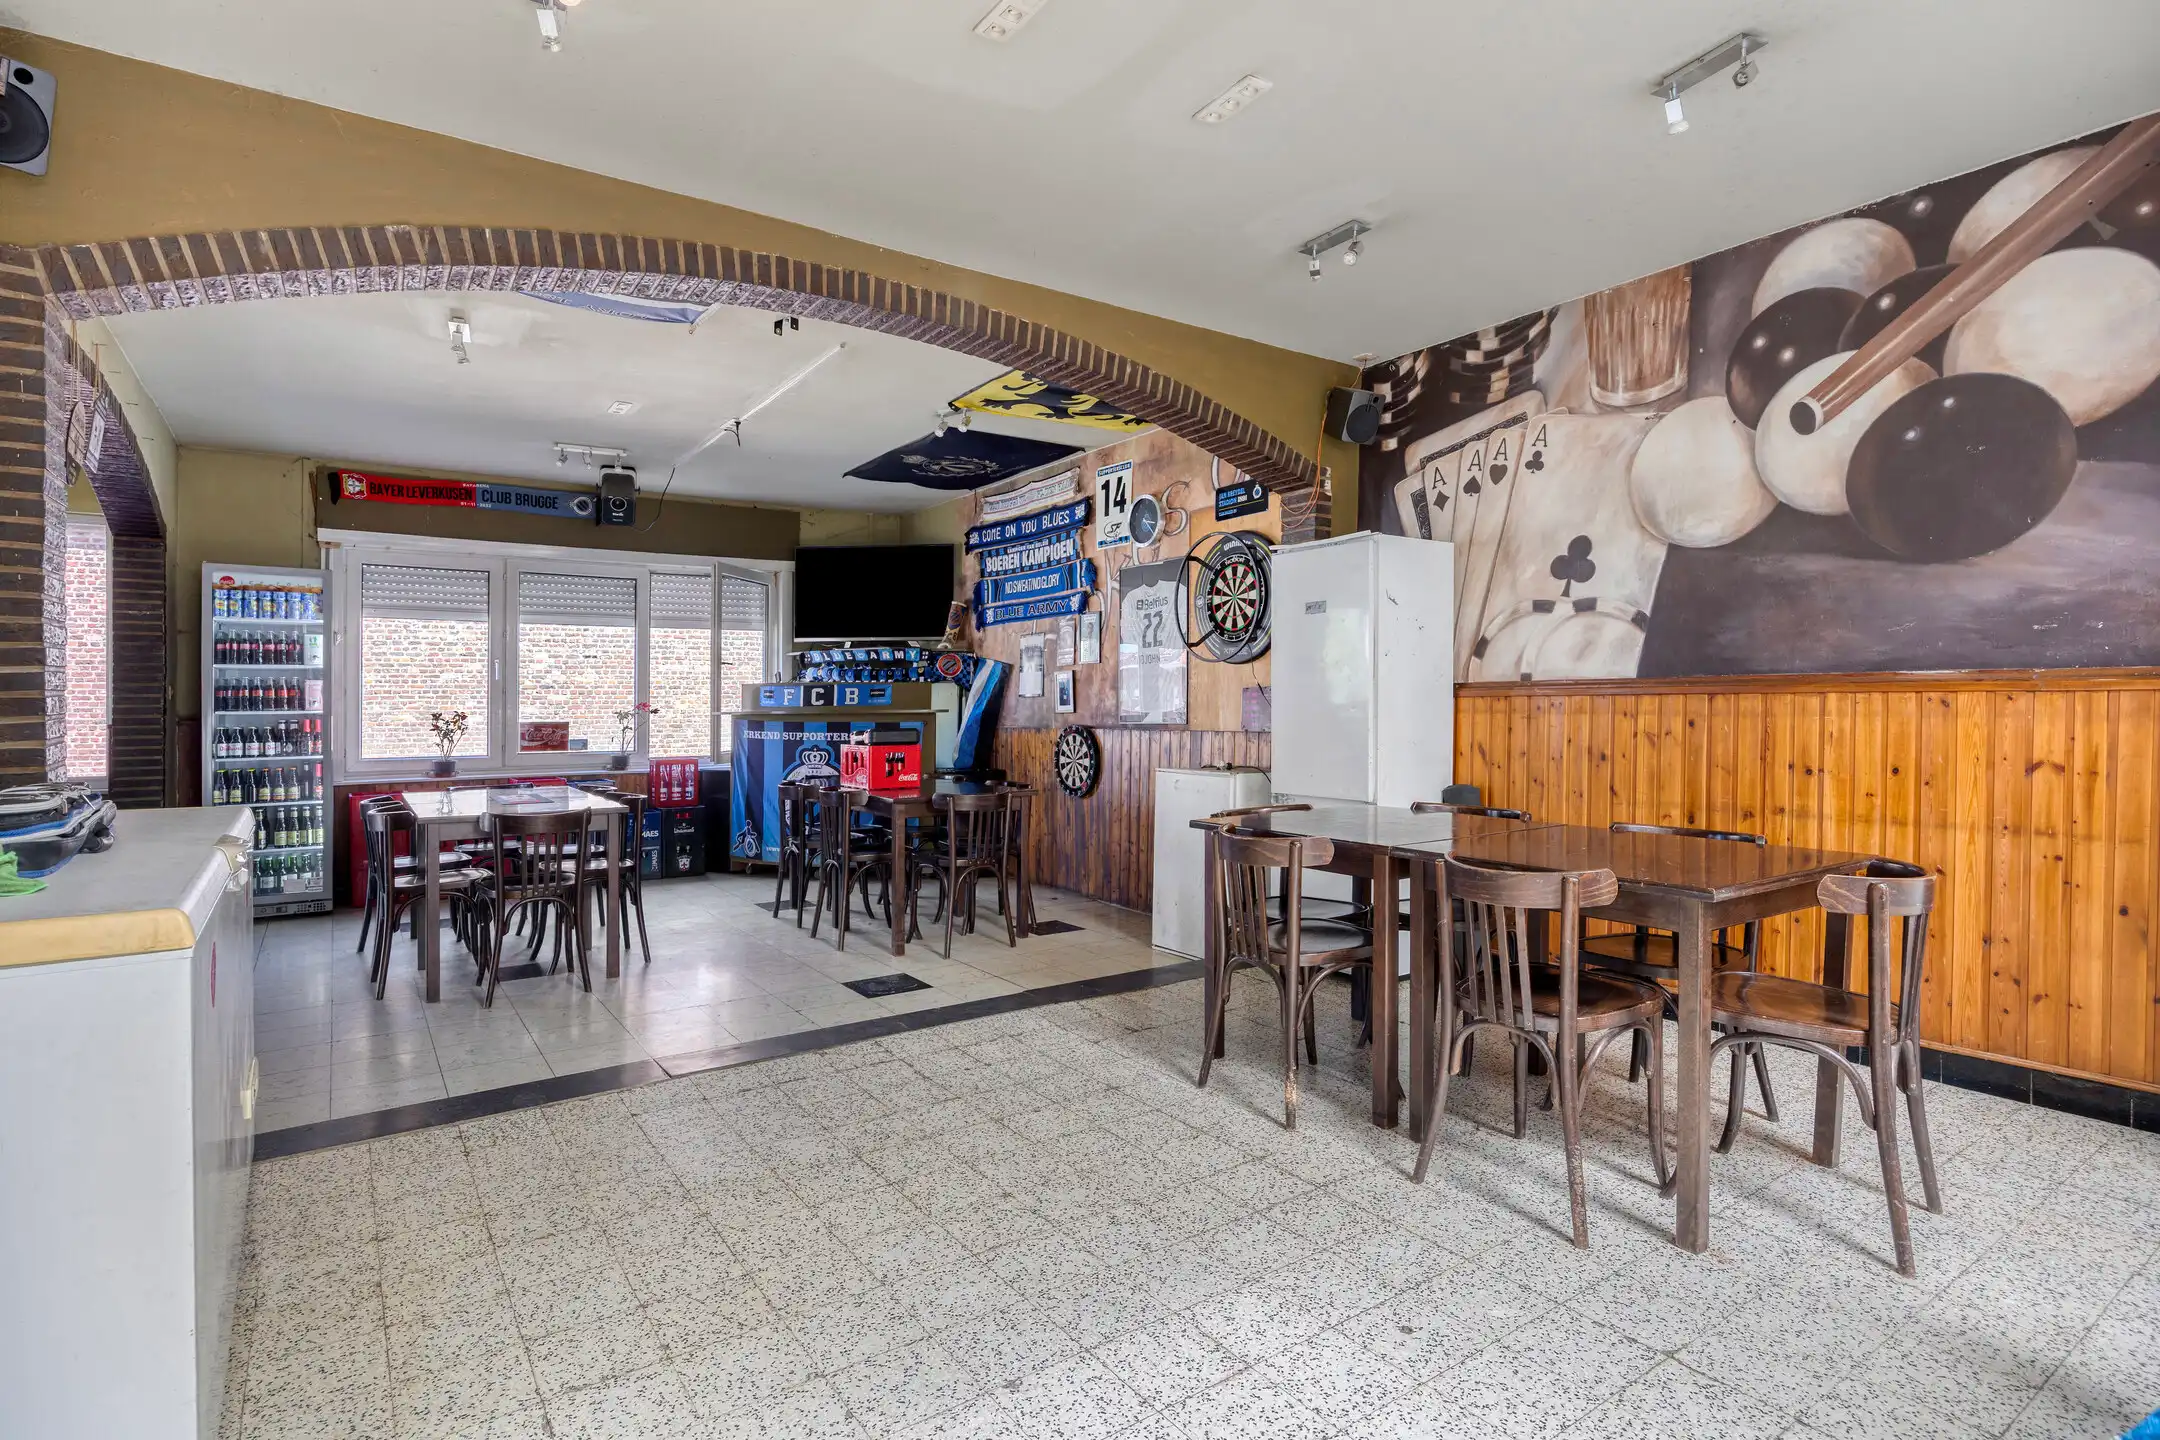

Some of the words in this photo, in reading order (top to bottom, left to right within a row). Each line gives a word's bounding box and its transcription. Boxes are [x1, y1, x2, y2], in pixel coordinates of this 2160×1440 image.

[1531, 423, 1548, 447] A
[1467, 449, 1482, 471] A
[1493, 437, 1508, 461] A
[1432, 466, 1447, 490] A
[369, 481, 404, 498] BAYER
[405, 486, 473, 501] LEVERKUSEN
[481, 489, 512, 504] CLUB
[515, 492, 559, 510] BRUGGE
[1101, 475, 1127, 517] 14
[982, 527, 1001, 542] COME
[1005, 523, 1016, 537] ON
[1021, 519, 1037, 534] YOU
[1042, 510, 1070, 528] BLUES
[985, 553, 1020, 572] BOEREN
[1022, 538, 1074, 567] KAMPIOEN
[995, 605, 1024, 620] BLUE
[1027, 599, 1068, 616] ARMY
[1142, 610, 1163, 648] 22
[813, 650, 854, 661] BLUE
[869, 649, 920, 661] ARMY
[743, 730, 780, 740] ERKEND
